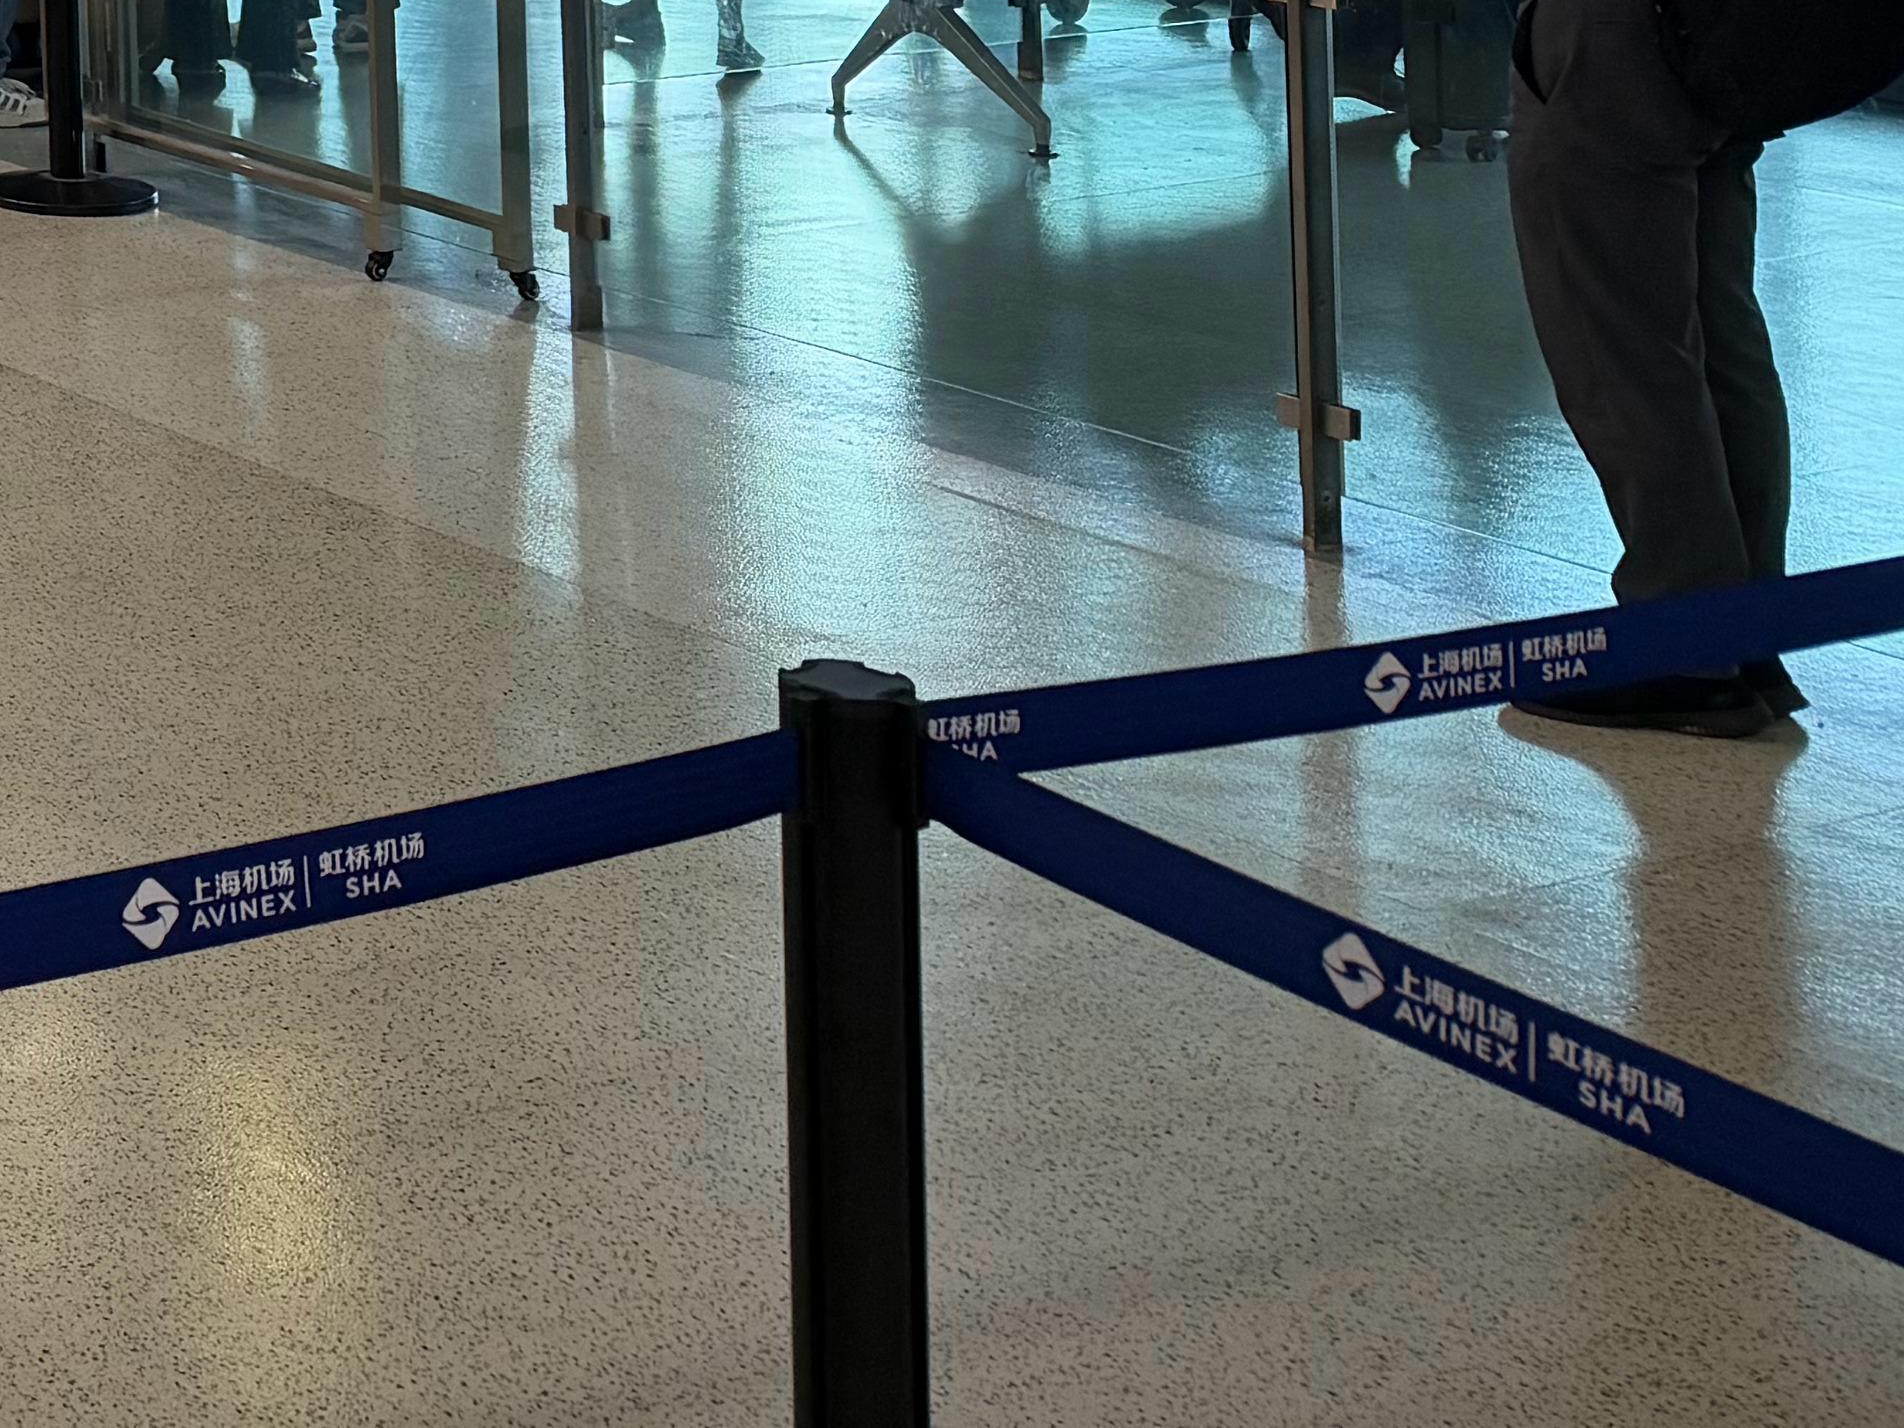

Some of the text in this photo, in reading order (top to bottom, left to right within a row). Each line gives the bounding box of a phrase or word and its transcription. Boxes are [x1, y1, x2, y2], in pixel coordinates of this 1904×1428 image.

[1418, 626, 1608, 679] 上海机场 虹桥机场
[1419, 657, 1588, 702] AVINEX SHA
[951, 740, 999, 762] HA
[189, 832, 425, 907] 上海机场 虹桥机场
[191, 869, 403, 933] AVINEX SHA
[1394, 965, 1686, 1119] 上海机场 虹桥机场
[1395, 1002, 1653, 1136] AVINEX SHA
